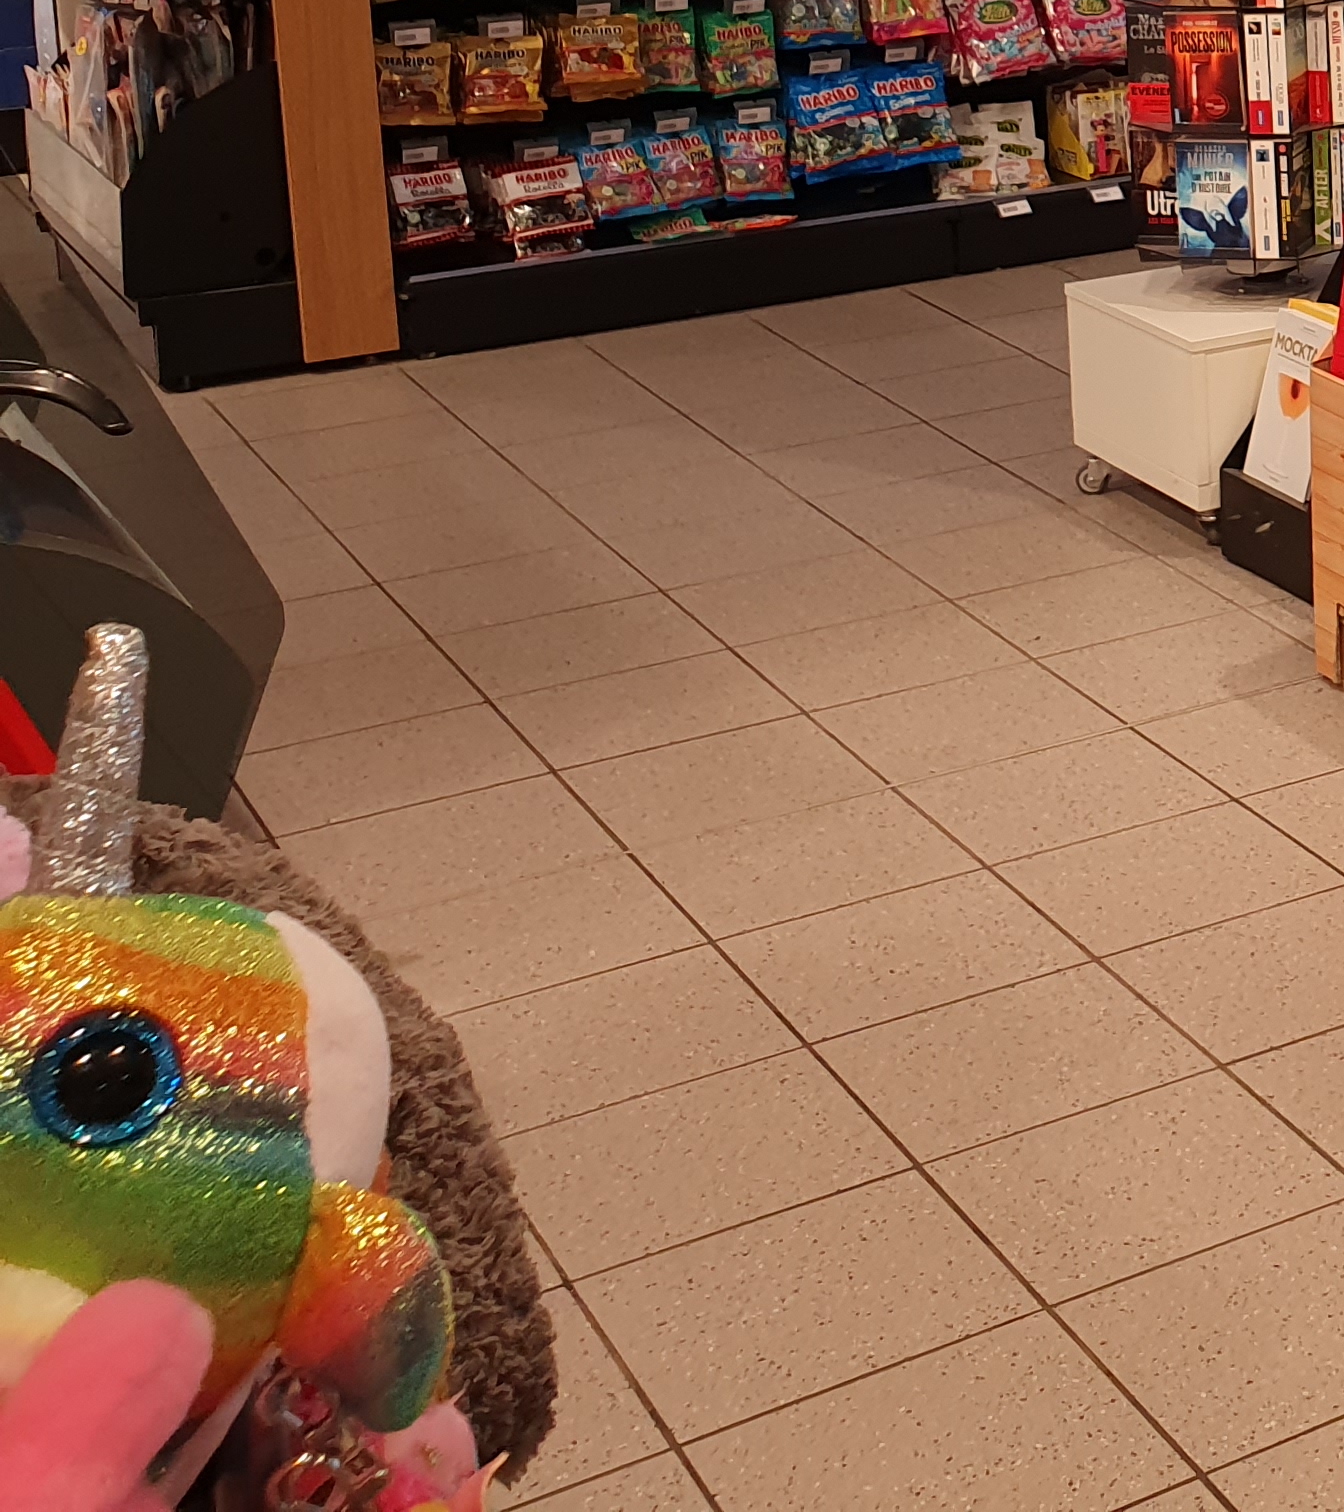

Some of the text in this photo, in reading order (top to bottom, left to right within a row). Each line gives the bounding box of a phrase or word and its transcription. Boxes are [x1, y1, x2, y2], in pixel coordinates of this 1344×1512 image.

[571, 25, 623, 37] HARIBO
[1170, 30, 1234, 53] POSSESSION
[876, 76, 935, 95] HARIBO
[801, 85, 858, 110] HARIBO
